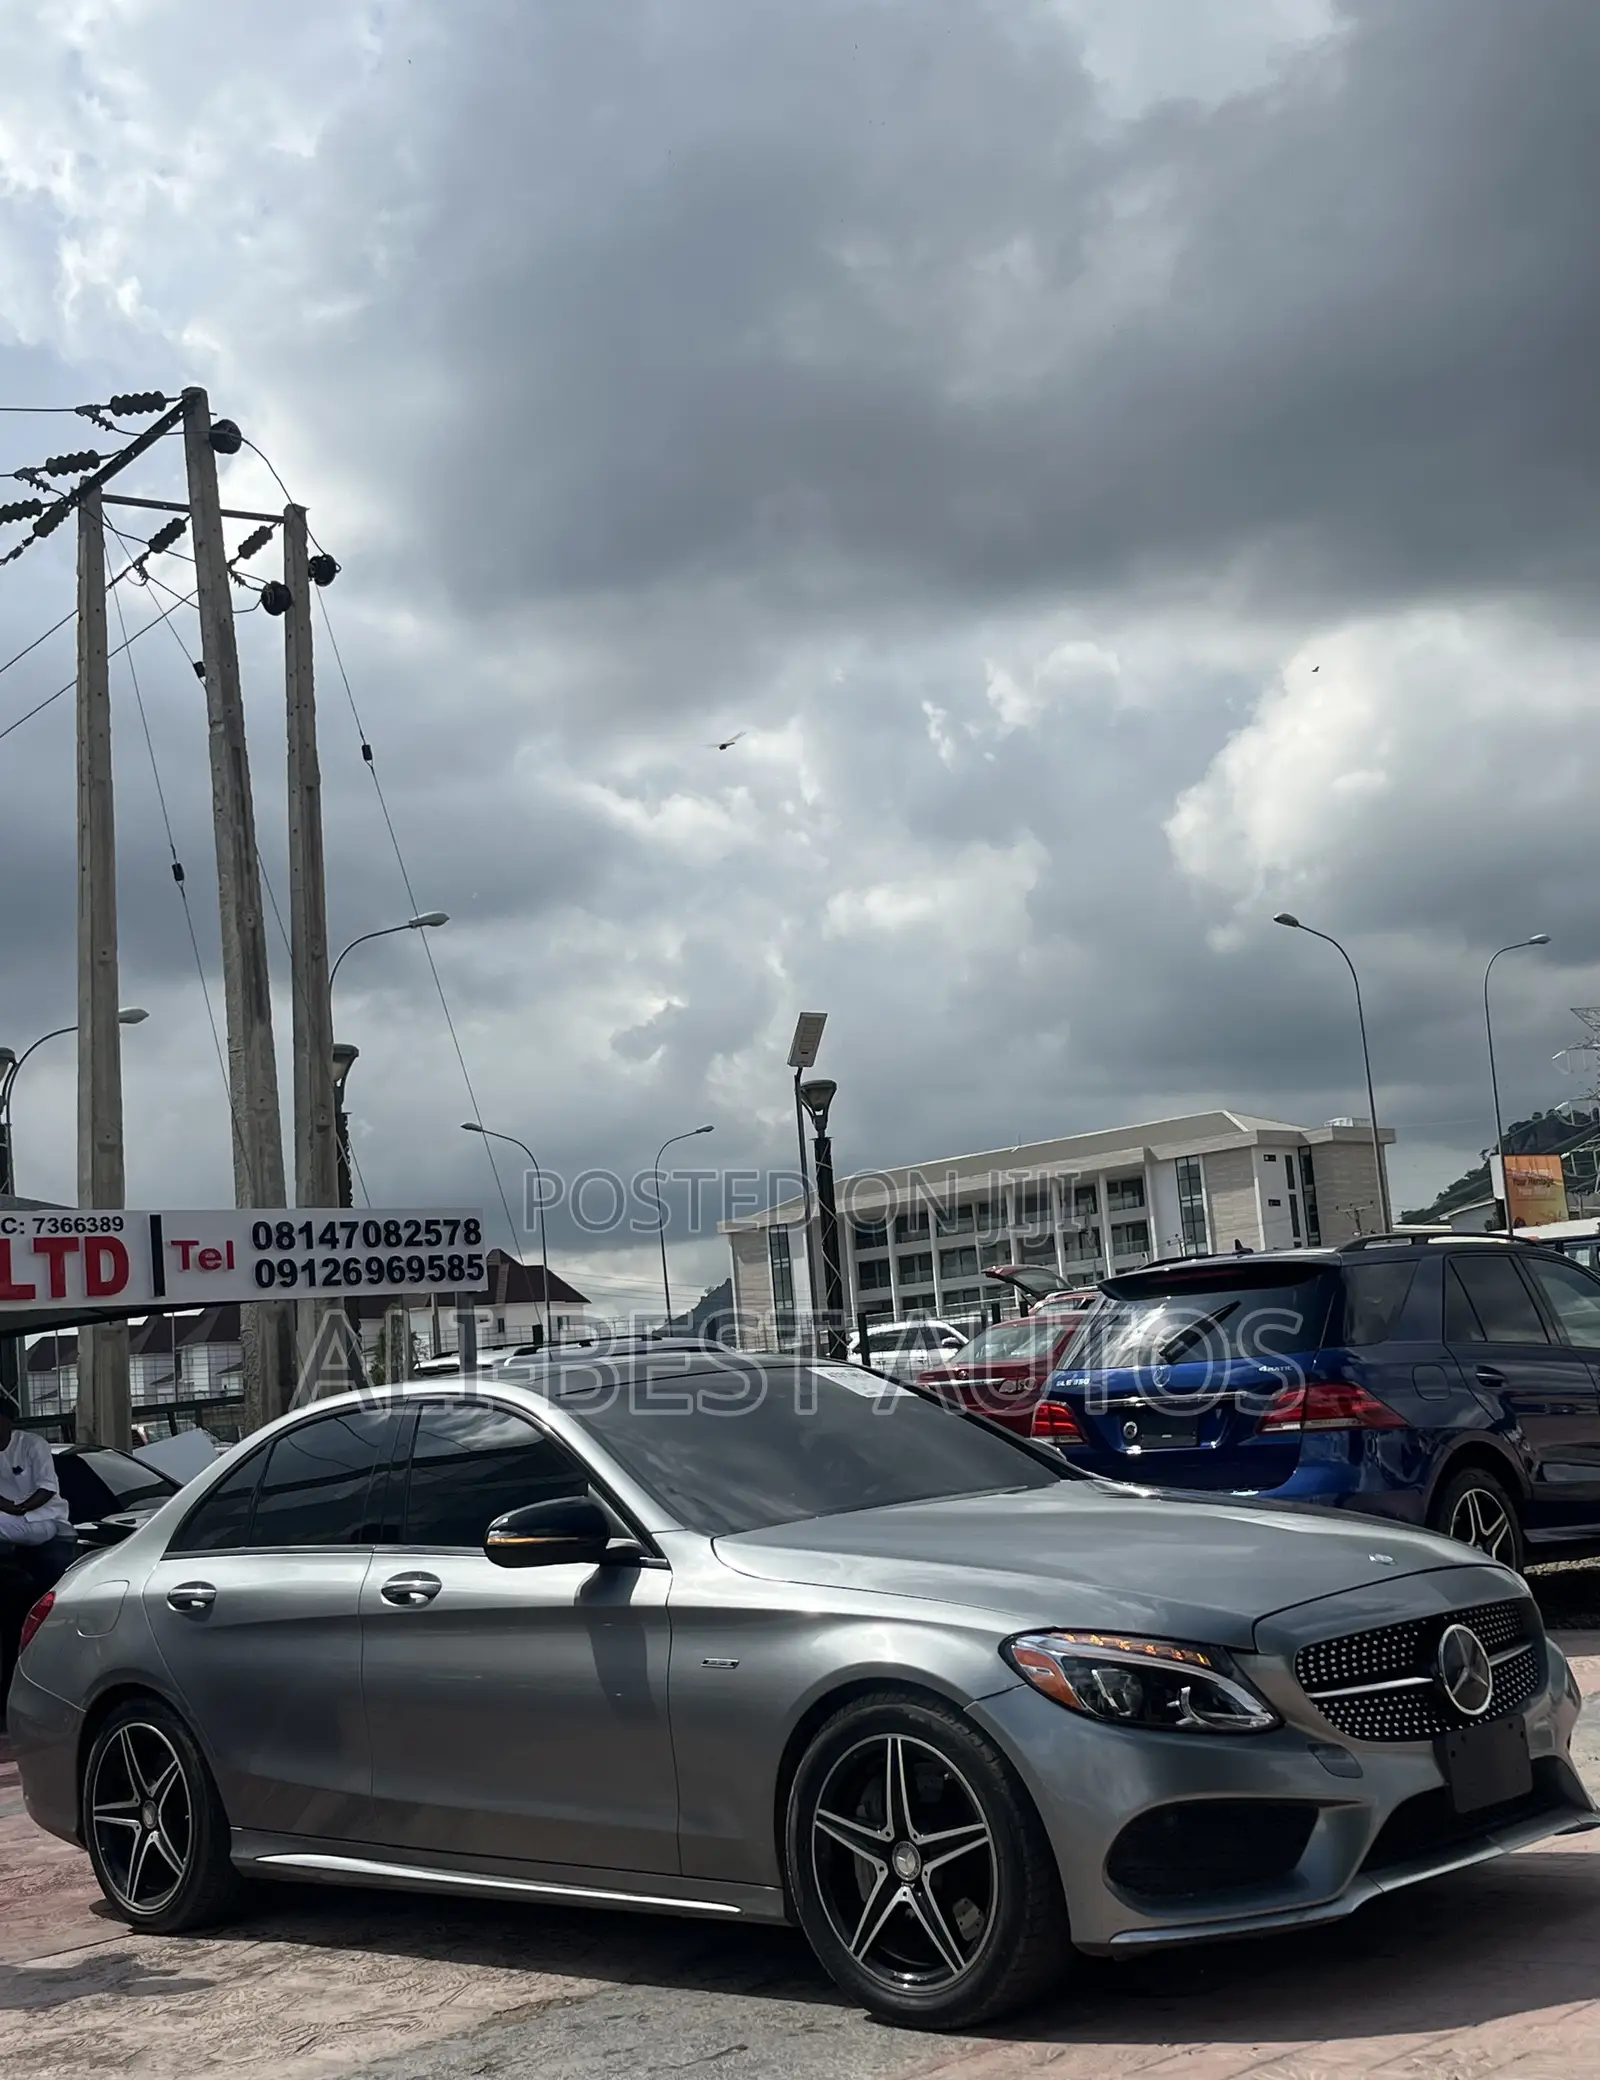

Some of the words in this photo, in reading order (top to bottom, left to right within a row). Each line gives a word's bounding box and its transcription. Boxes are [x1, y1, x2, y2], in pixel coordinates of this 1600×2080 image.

[32, 1215, 125, 1235] 7366389
[252, 1217, 482, 1251] 08147082578
[0, 1235, 130, 1300] LTD
[170, 1240, 236, 1271] Tel
[254, 1253, 485, 1289] 09126969585
